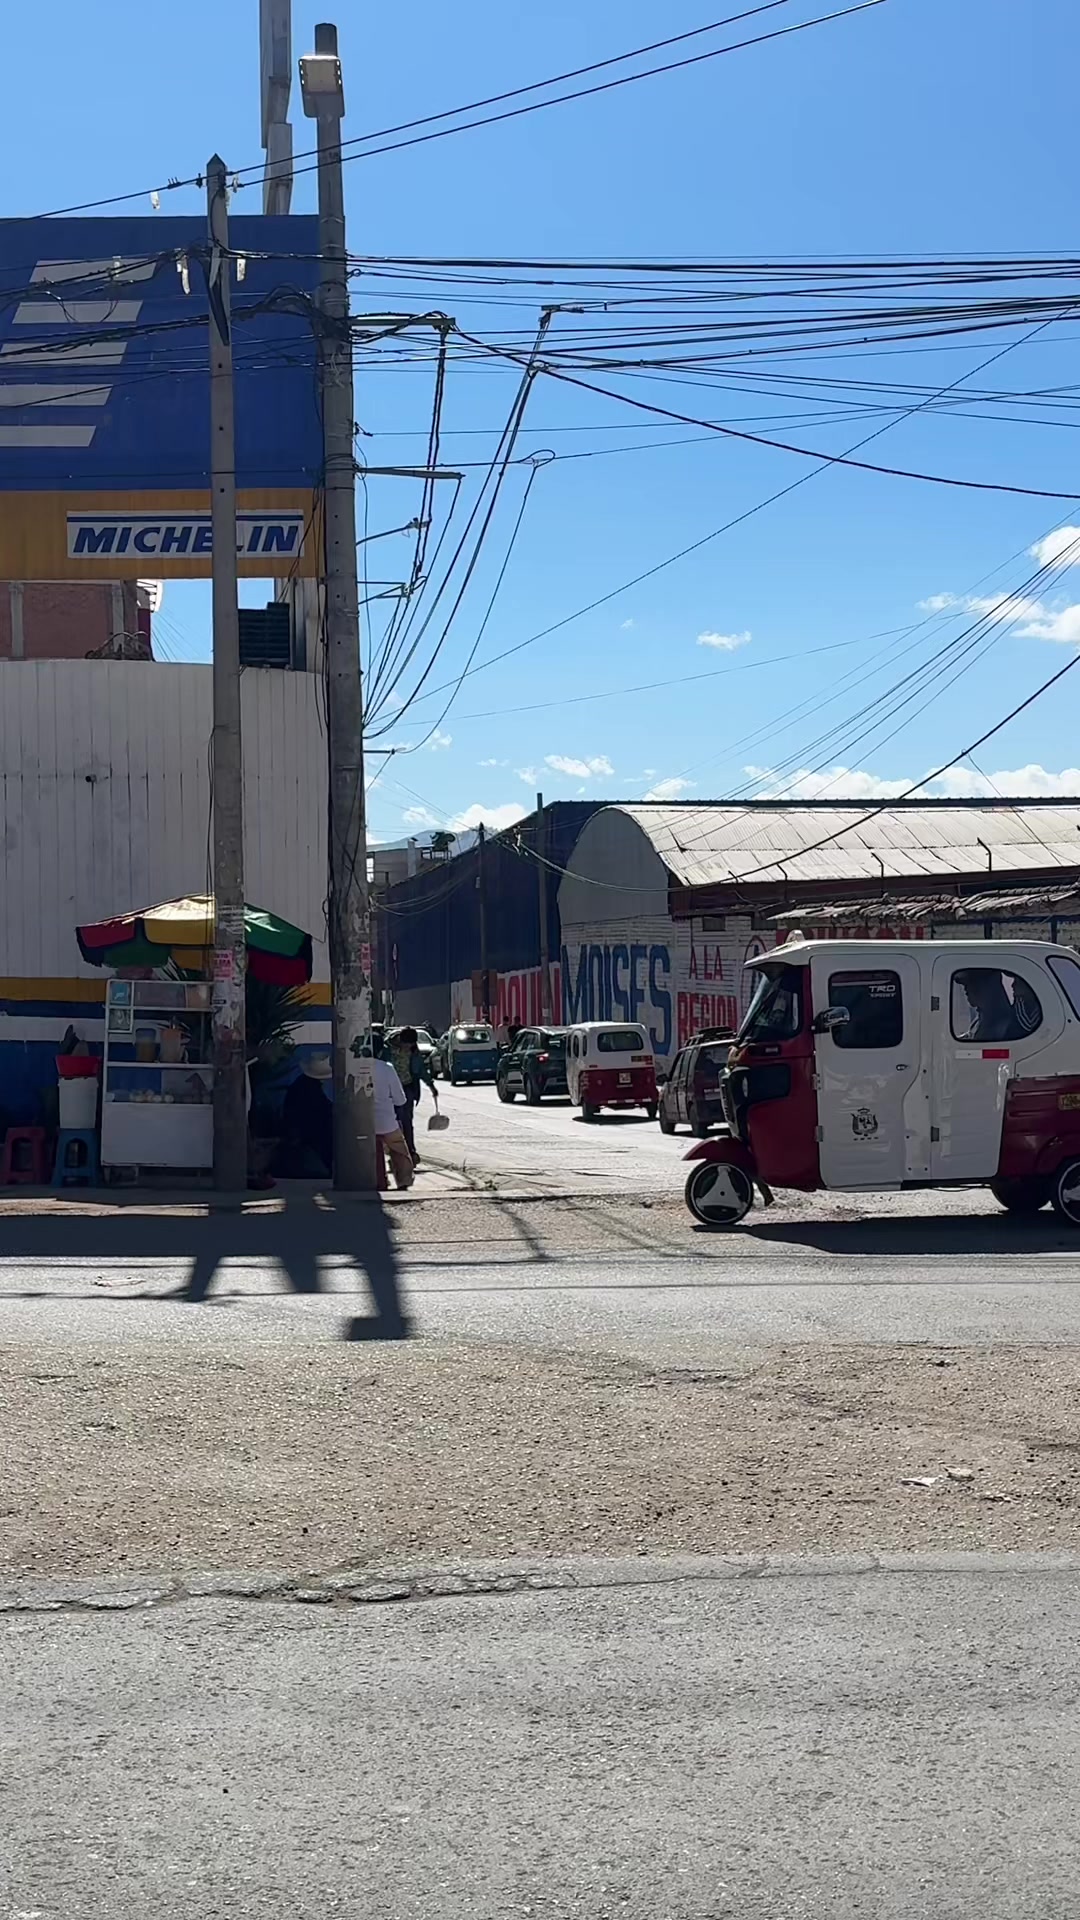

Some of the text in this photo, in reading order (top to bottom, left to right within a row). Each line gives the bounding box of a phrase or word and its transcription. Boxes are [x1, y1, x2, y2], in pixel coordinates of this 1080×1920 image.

[73, 525, 299, 553] MICHEIN
[689, 946, 724, 981] A LA
[562, 943, 672, 1056] MOISES
